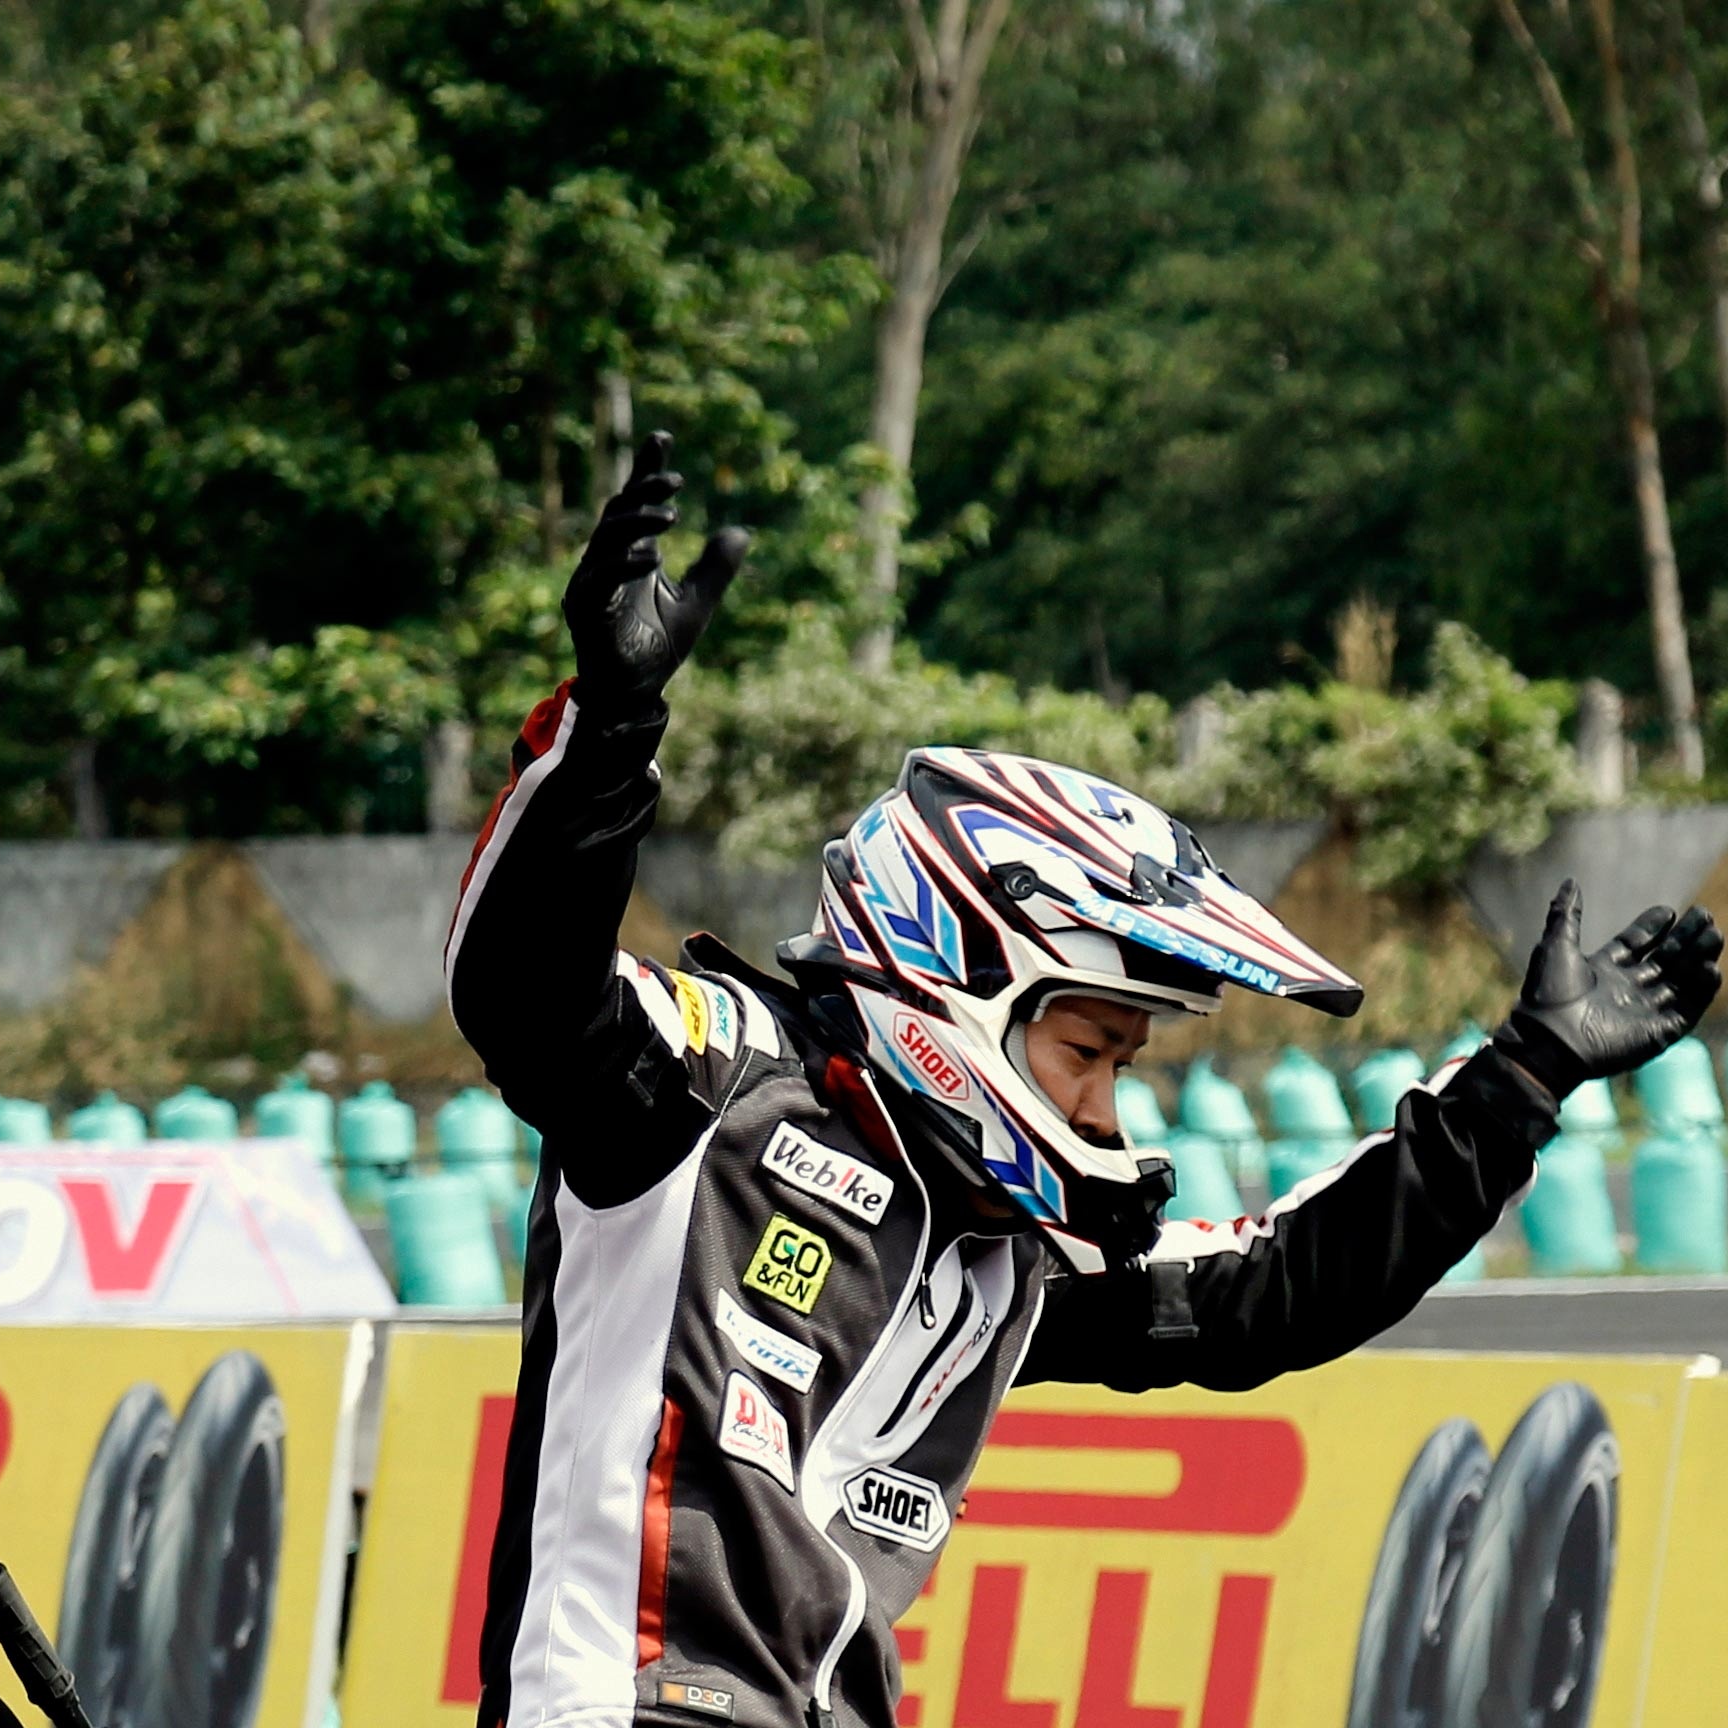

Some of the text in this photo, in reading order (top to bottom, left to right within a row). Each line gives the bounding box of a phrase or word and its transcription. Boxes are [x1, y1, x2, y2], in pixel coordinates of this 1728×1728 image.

[899, 1022, 963, 1094] SHOEI
[769, 1229, 823, 1279] GO
[858, 1477, 930, 1532] SHOEI
